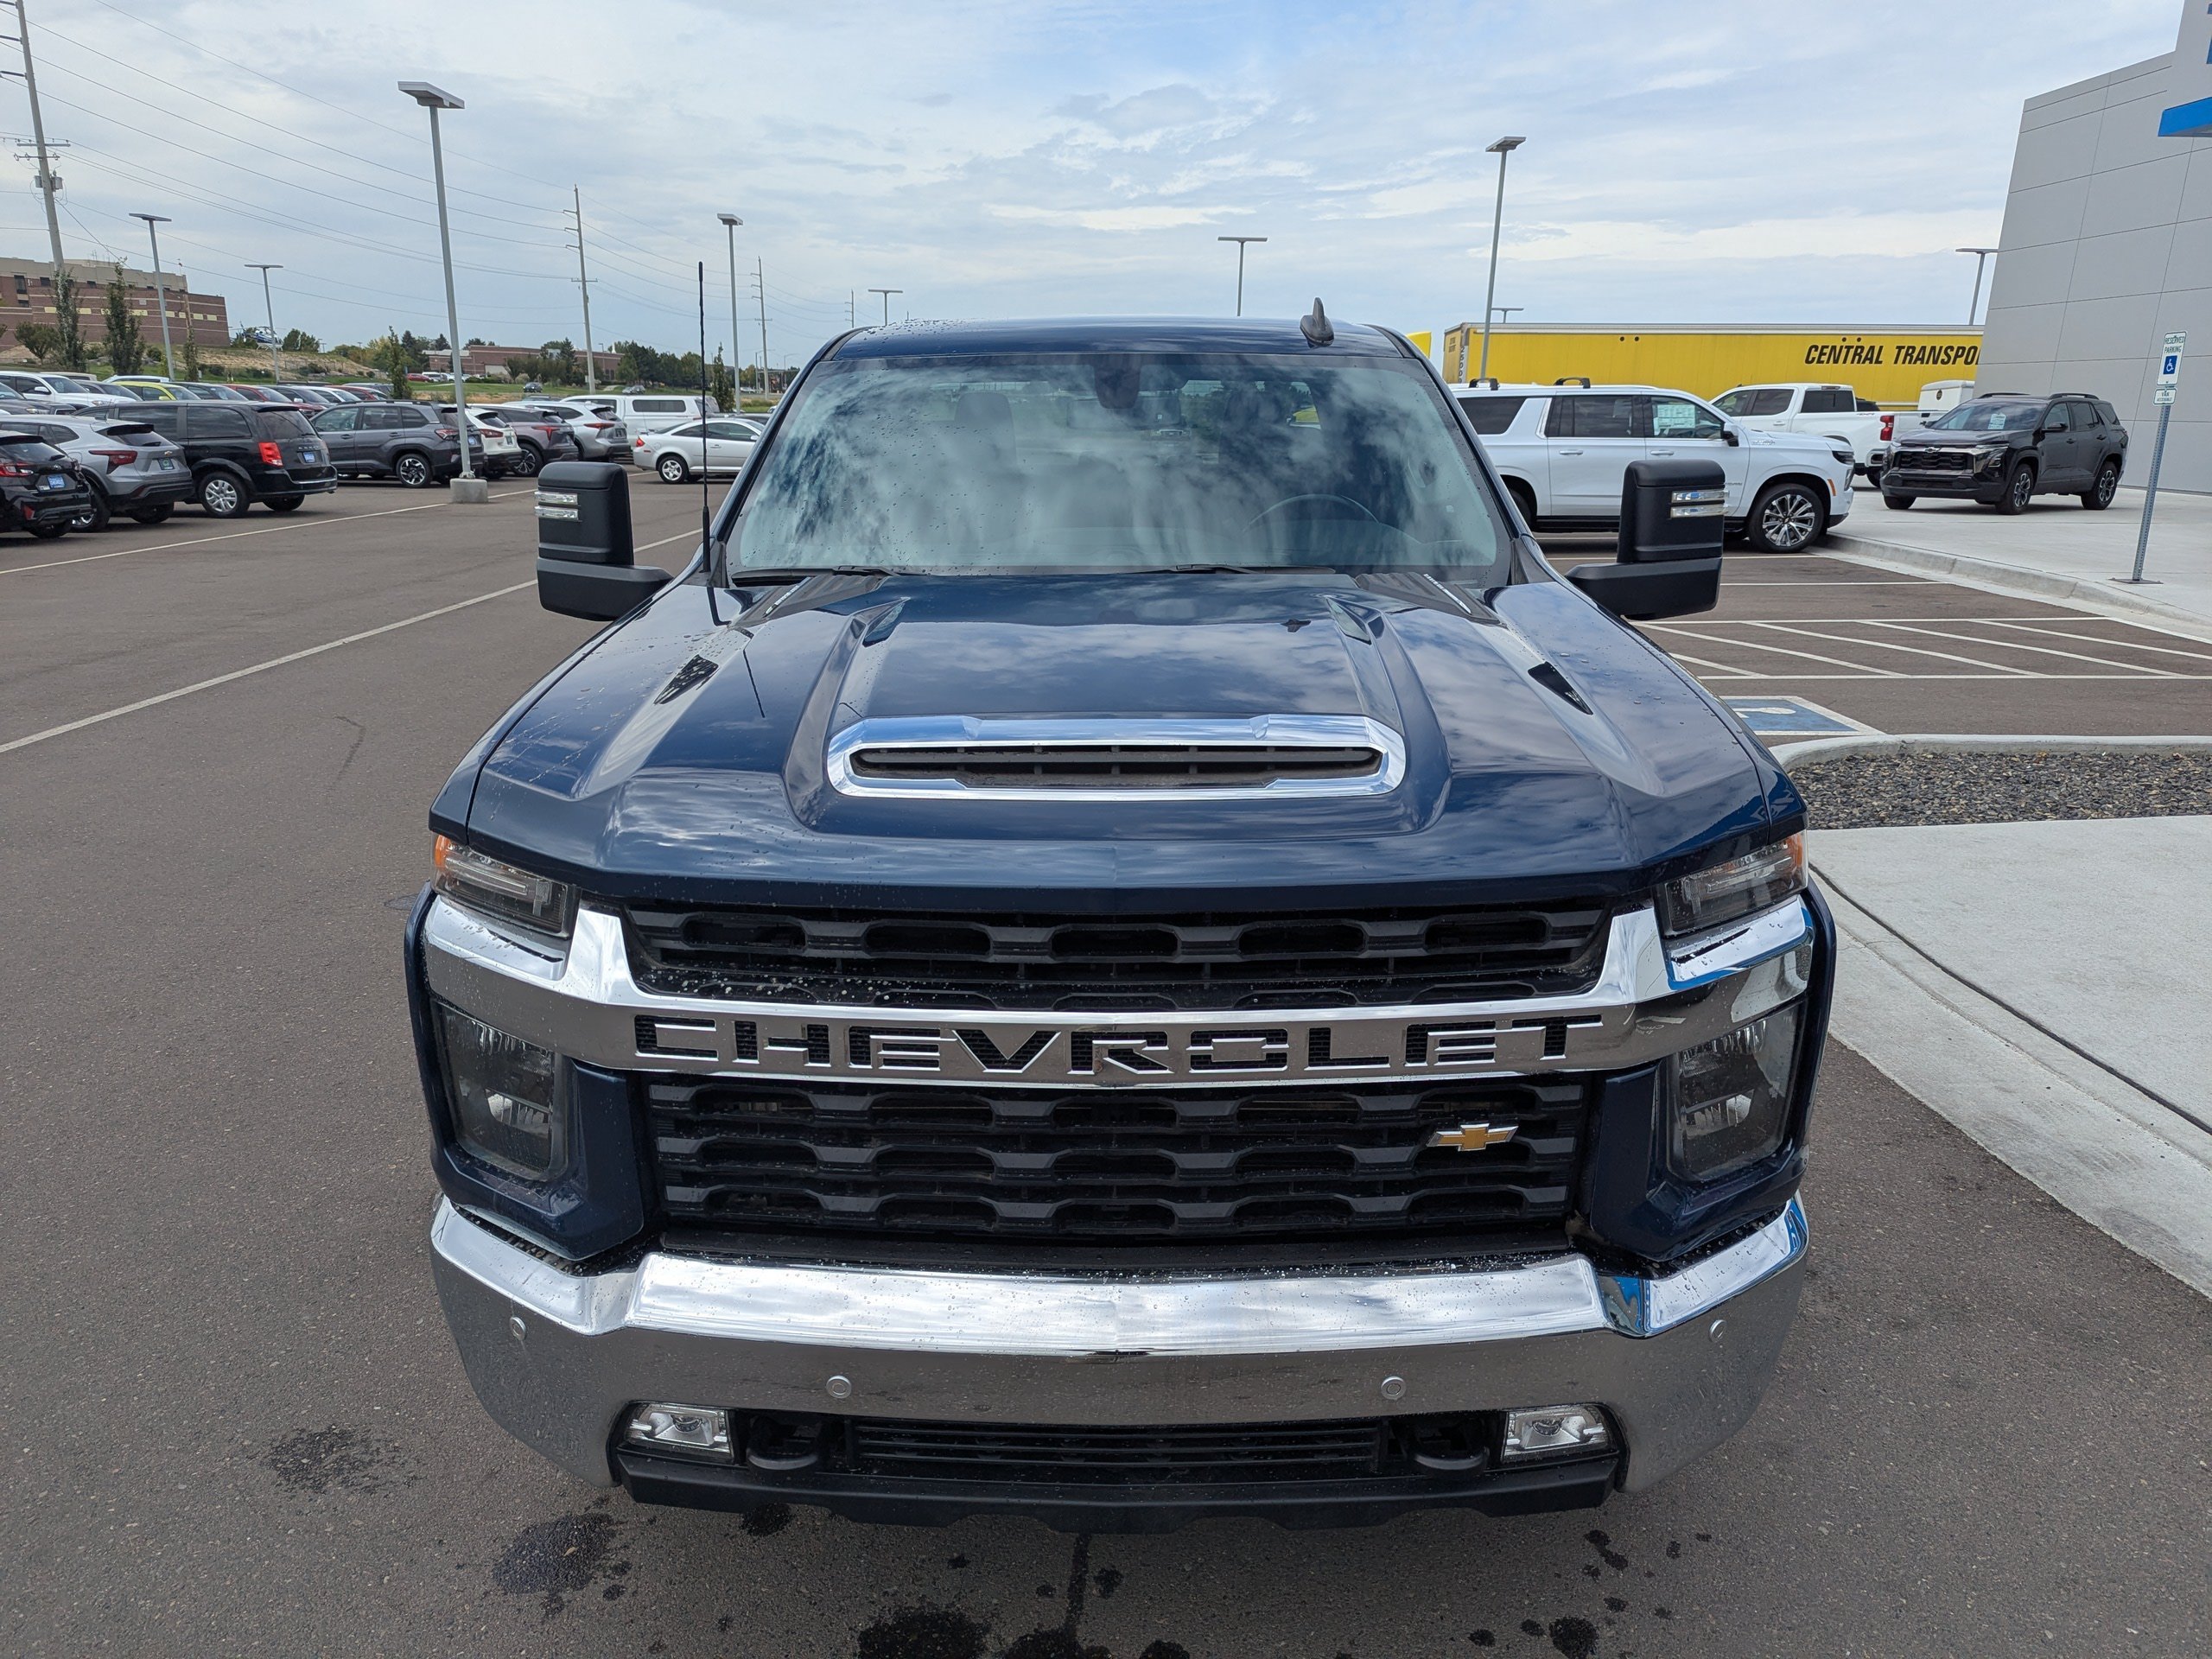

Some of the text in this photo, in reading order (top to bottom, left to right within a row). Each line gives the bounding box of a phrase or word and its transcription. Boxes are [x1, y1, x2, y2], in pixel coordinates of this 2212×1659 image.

[1804, 344, 1981, 365] CENTRAL TRANSPO
[635, 1014, 1604, 1075] CHEVROLET
